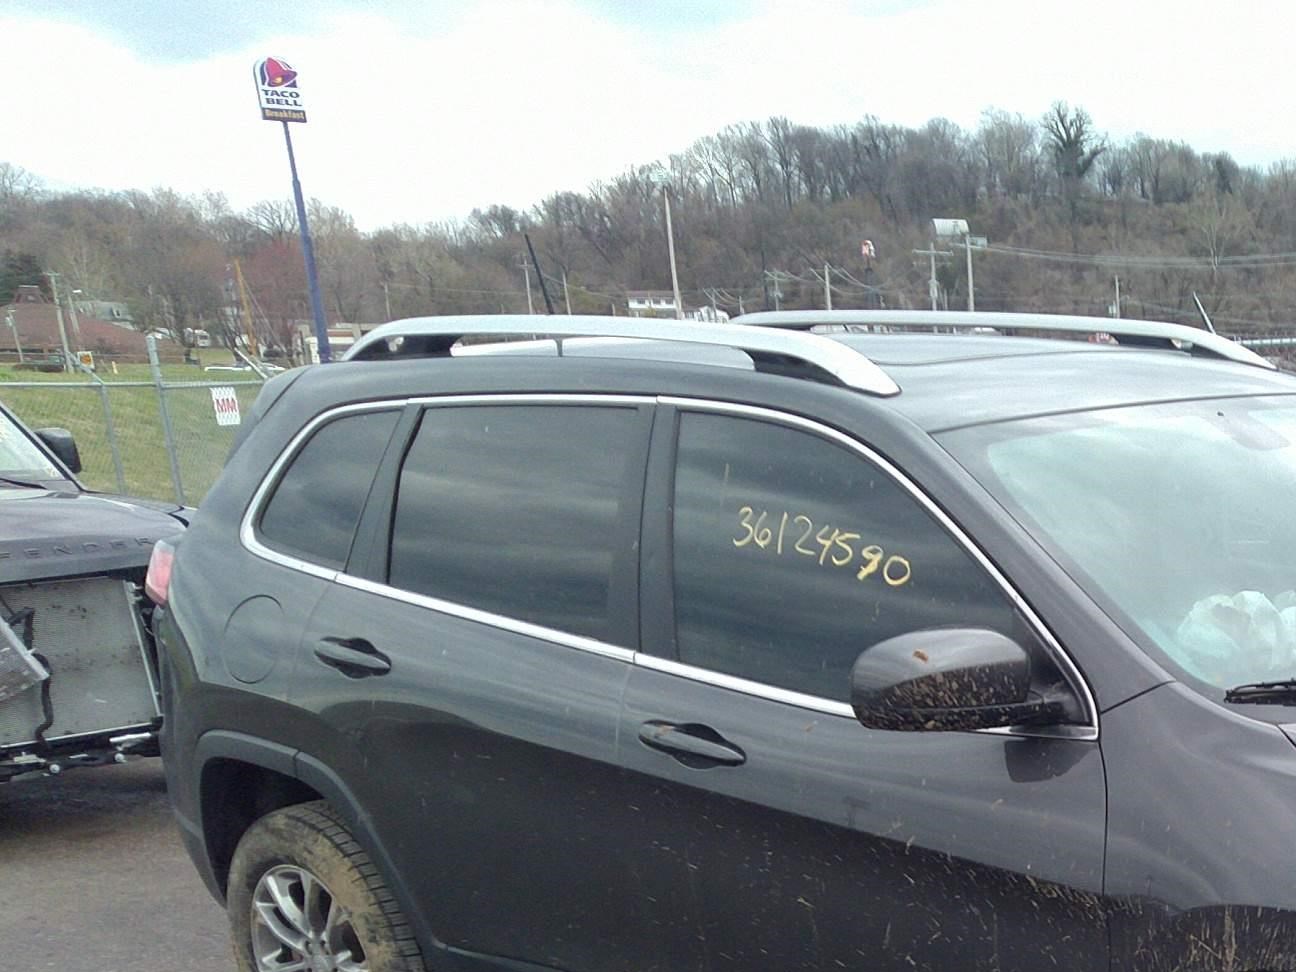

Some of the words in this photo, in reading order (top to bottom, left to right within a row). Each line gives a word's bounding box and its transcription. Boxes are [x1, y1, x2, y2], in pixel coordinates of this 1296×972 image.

[261, 89, 300, 98] TACO
[266, 97, 303, 106] BELL
[215, 398, 238, 413] MM
[733, 506, 911, 586] 36124590
